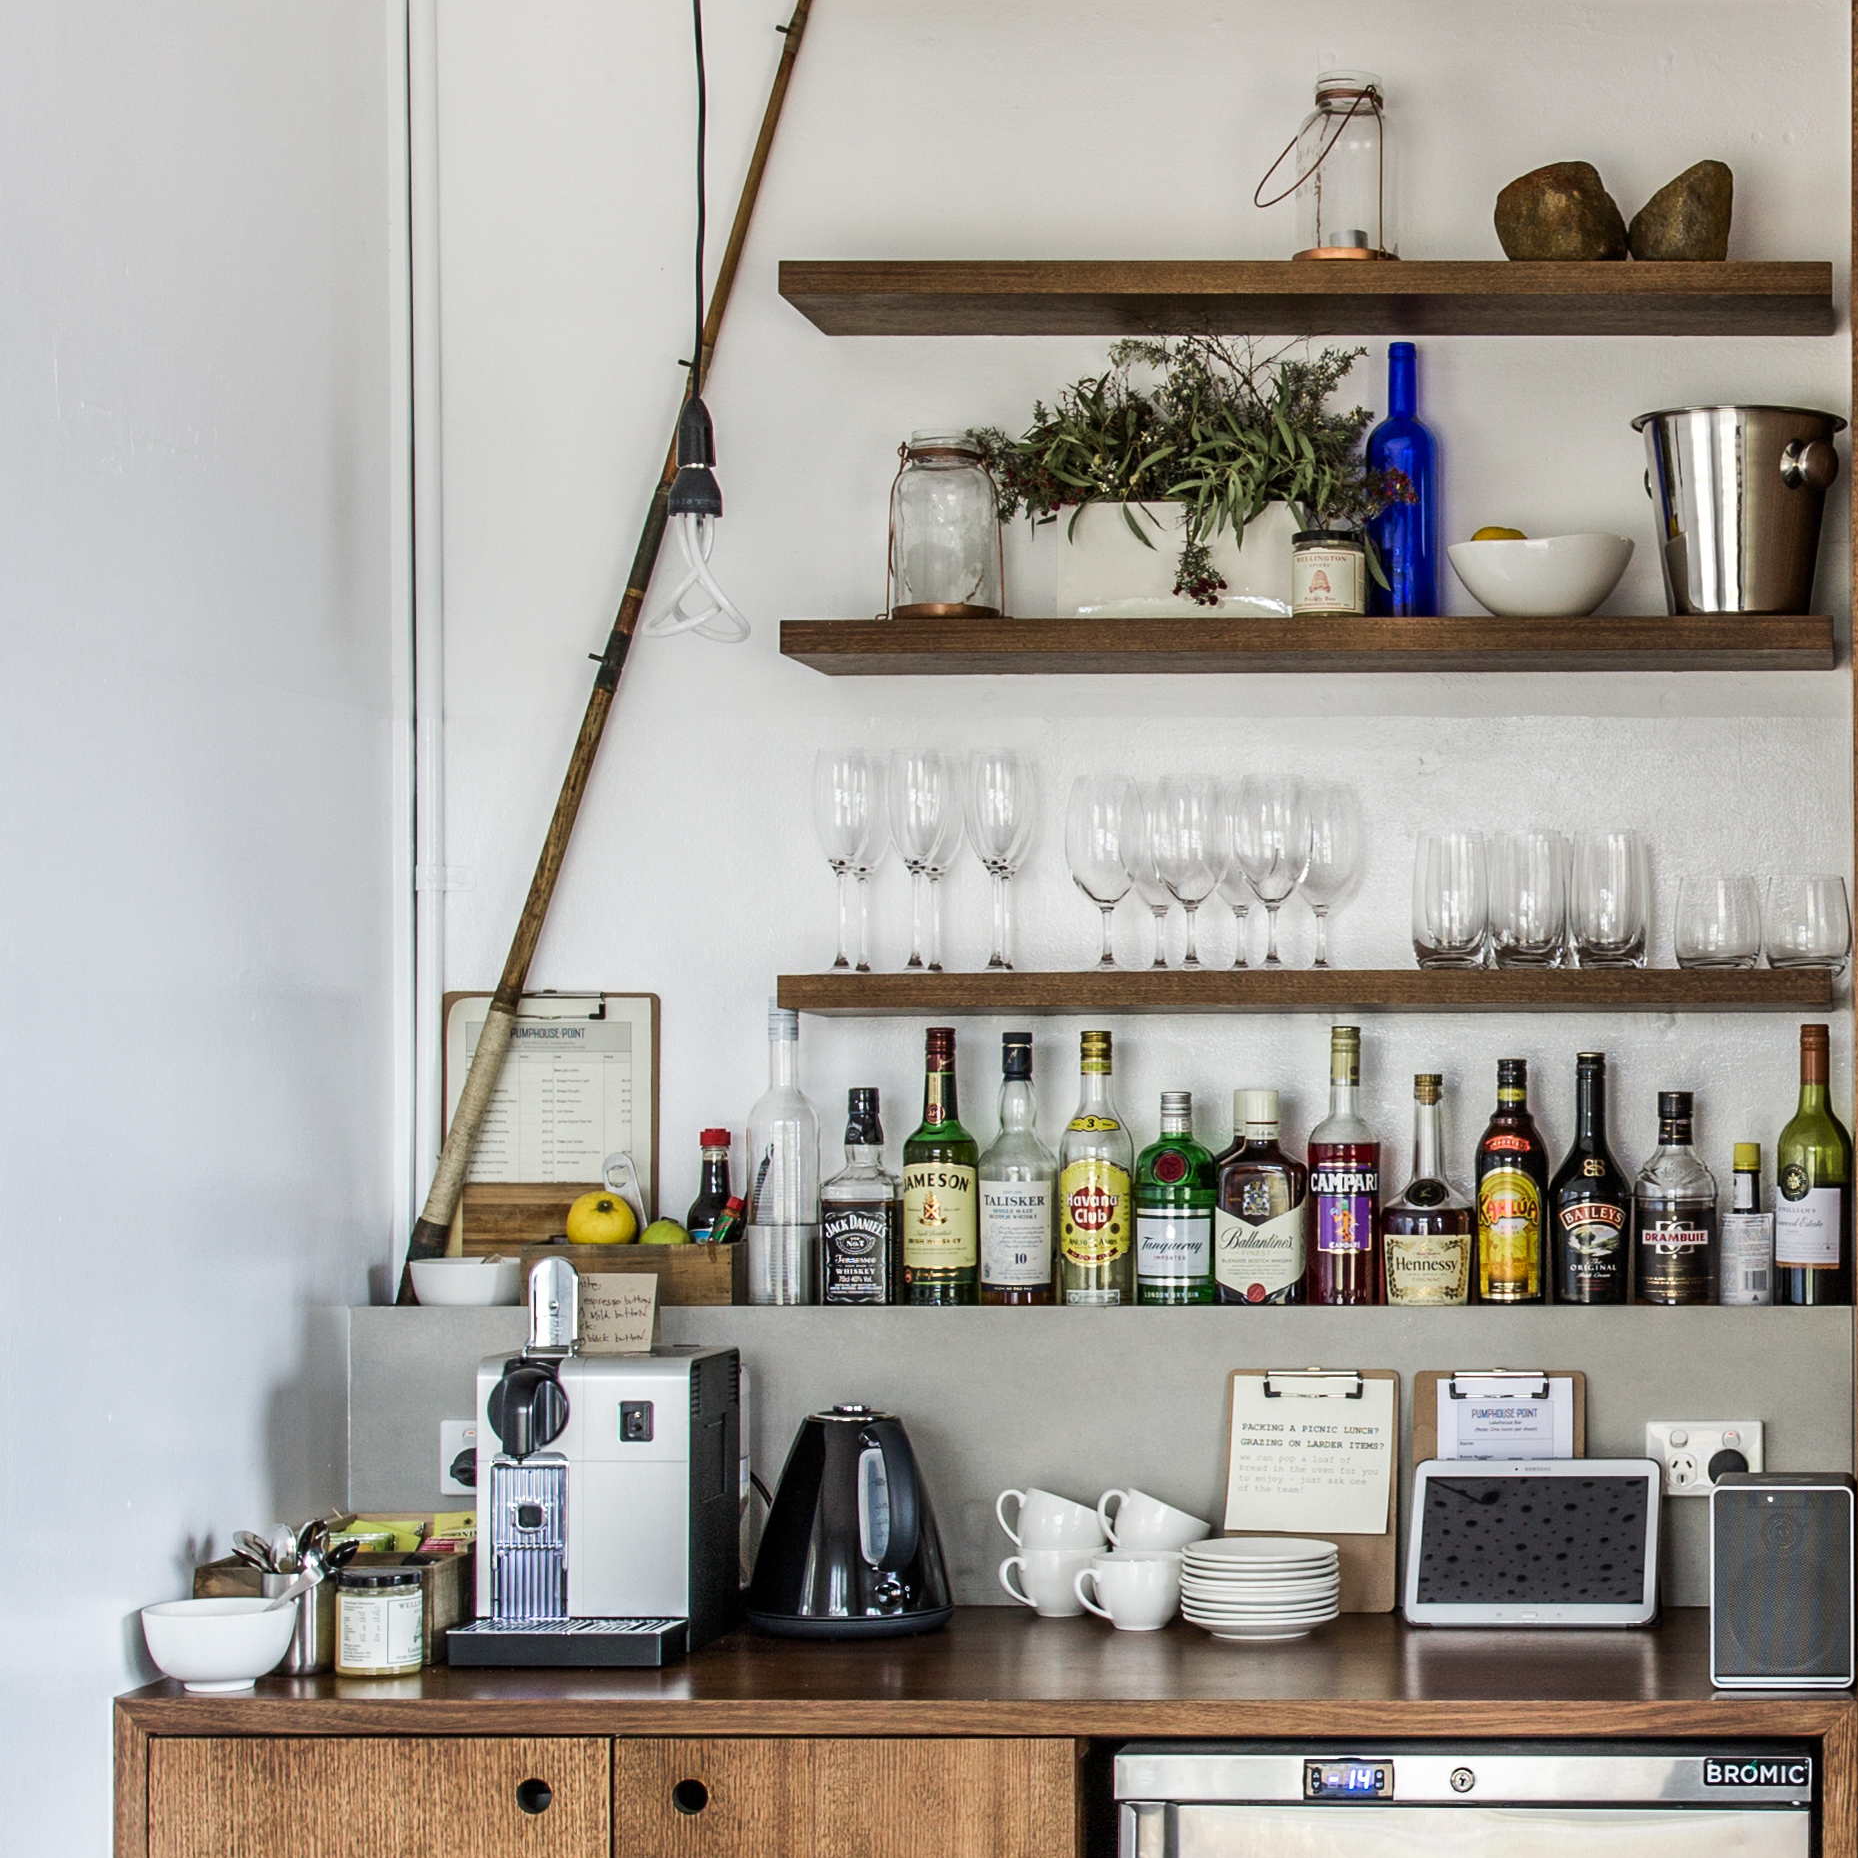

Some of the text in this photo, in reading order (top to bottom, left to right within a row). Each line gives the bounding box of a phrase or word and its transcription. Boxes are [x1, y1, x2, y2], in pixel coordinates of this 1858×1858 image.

[1087, 1118, 1095, 1128] 3
[904, 1173, 970, 1193] JAMESON
[1311, 1173, 1378, 1192] CAMPARI
[984, 1195, 1045, 1206] TALISKER
[1066, 1193, 1118, 1207] Havana
[1479, 1193, 1539, 1225] KAHLÚA
[1565, 1206, 1622, 1224] BAILEYS
[1075, 1209, 1107, 1224] Club
[825, 1214, 887, 1238] JACK DANIEL'S
[1219, 1226, 1293, 1250] Ballantine's
[1645, 1232, 1706, 1242] DRAMBUIE
[1141, 1237, 1203, 1254] Tanqueray
[835, 1254, 876, 1264] Tennessee
[1014, 1253, 1027, 1265] 10
[1396, 1257, 1458, 1273] Hennessy
[584, 1297, 621, 1309] espresso
[1517, 1408, 1538, 1418] POINT
[1242, 1423, 1284, 1433] PACKING
[1302, 1425, 1338, 1434] PICNIC
[1343, 1427, 1379, 1435] LUNCH?
[1240, 1438, 1283, 1447] GRAZING
[1307, 1441, 1343, 1449] LARDER
[1349, 1442, 1384, 1450] ITEMS?
[1239, 1464, 1268, 1472] bread
[1255, 1476, 1283, 1484] enjoy
[1300, 1476, 1322, 1485] just
[1327, 1477, 1345, 1485] ask
[1277, 1485, 1304, 1493] team!
[1707, 1764, 1805, 1784] BROMIC
